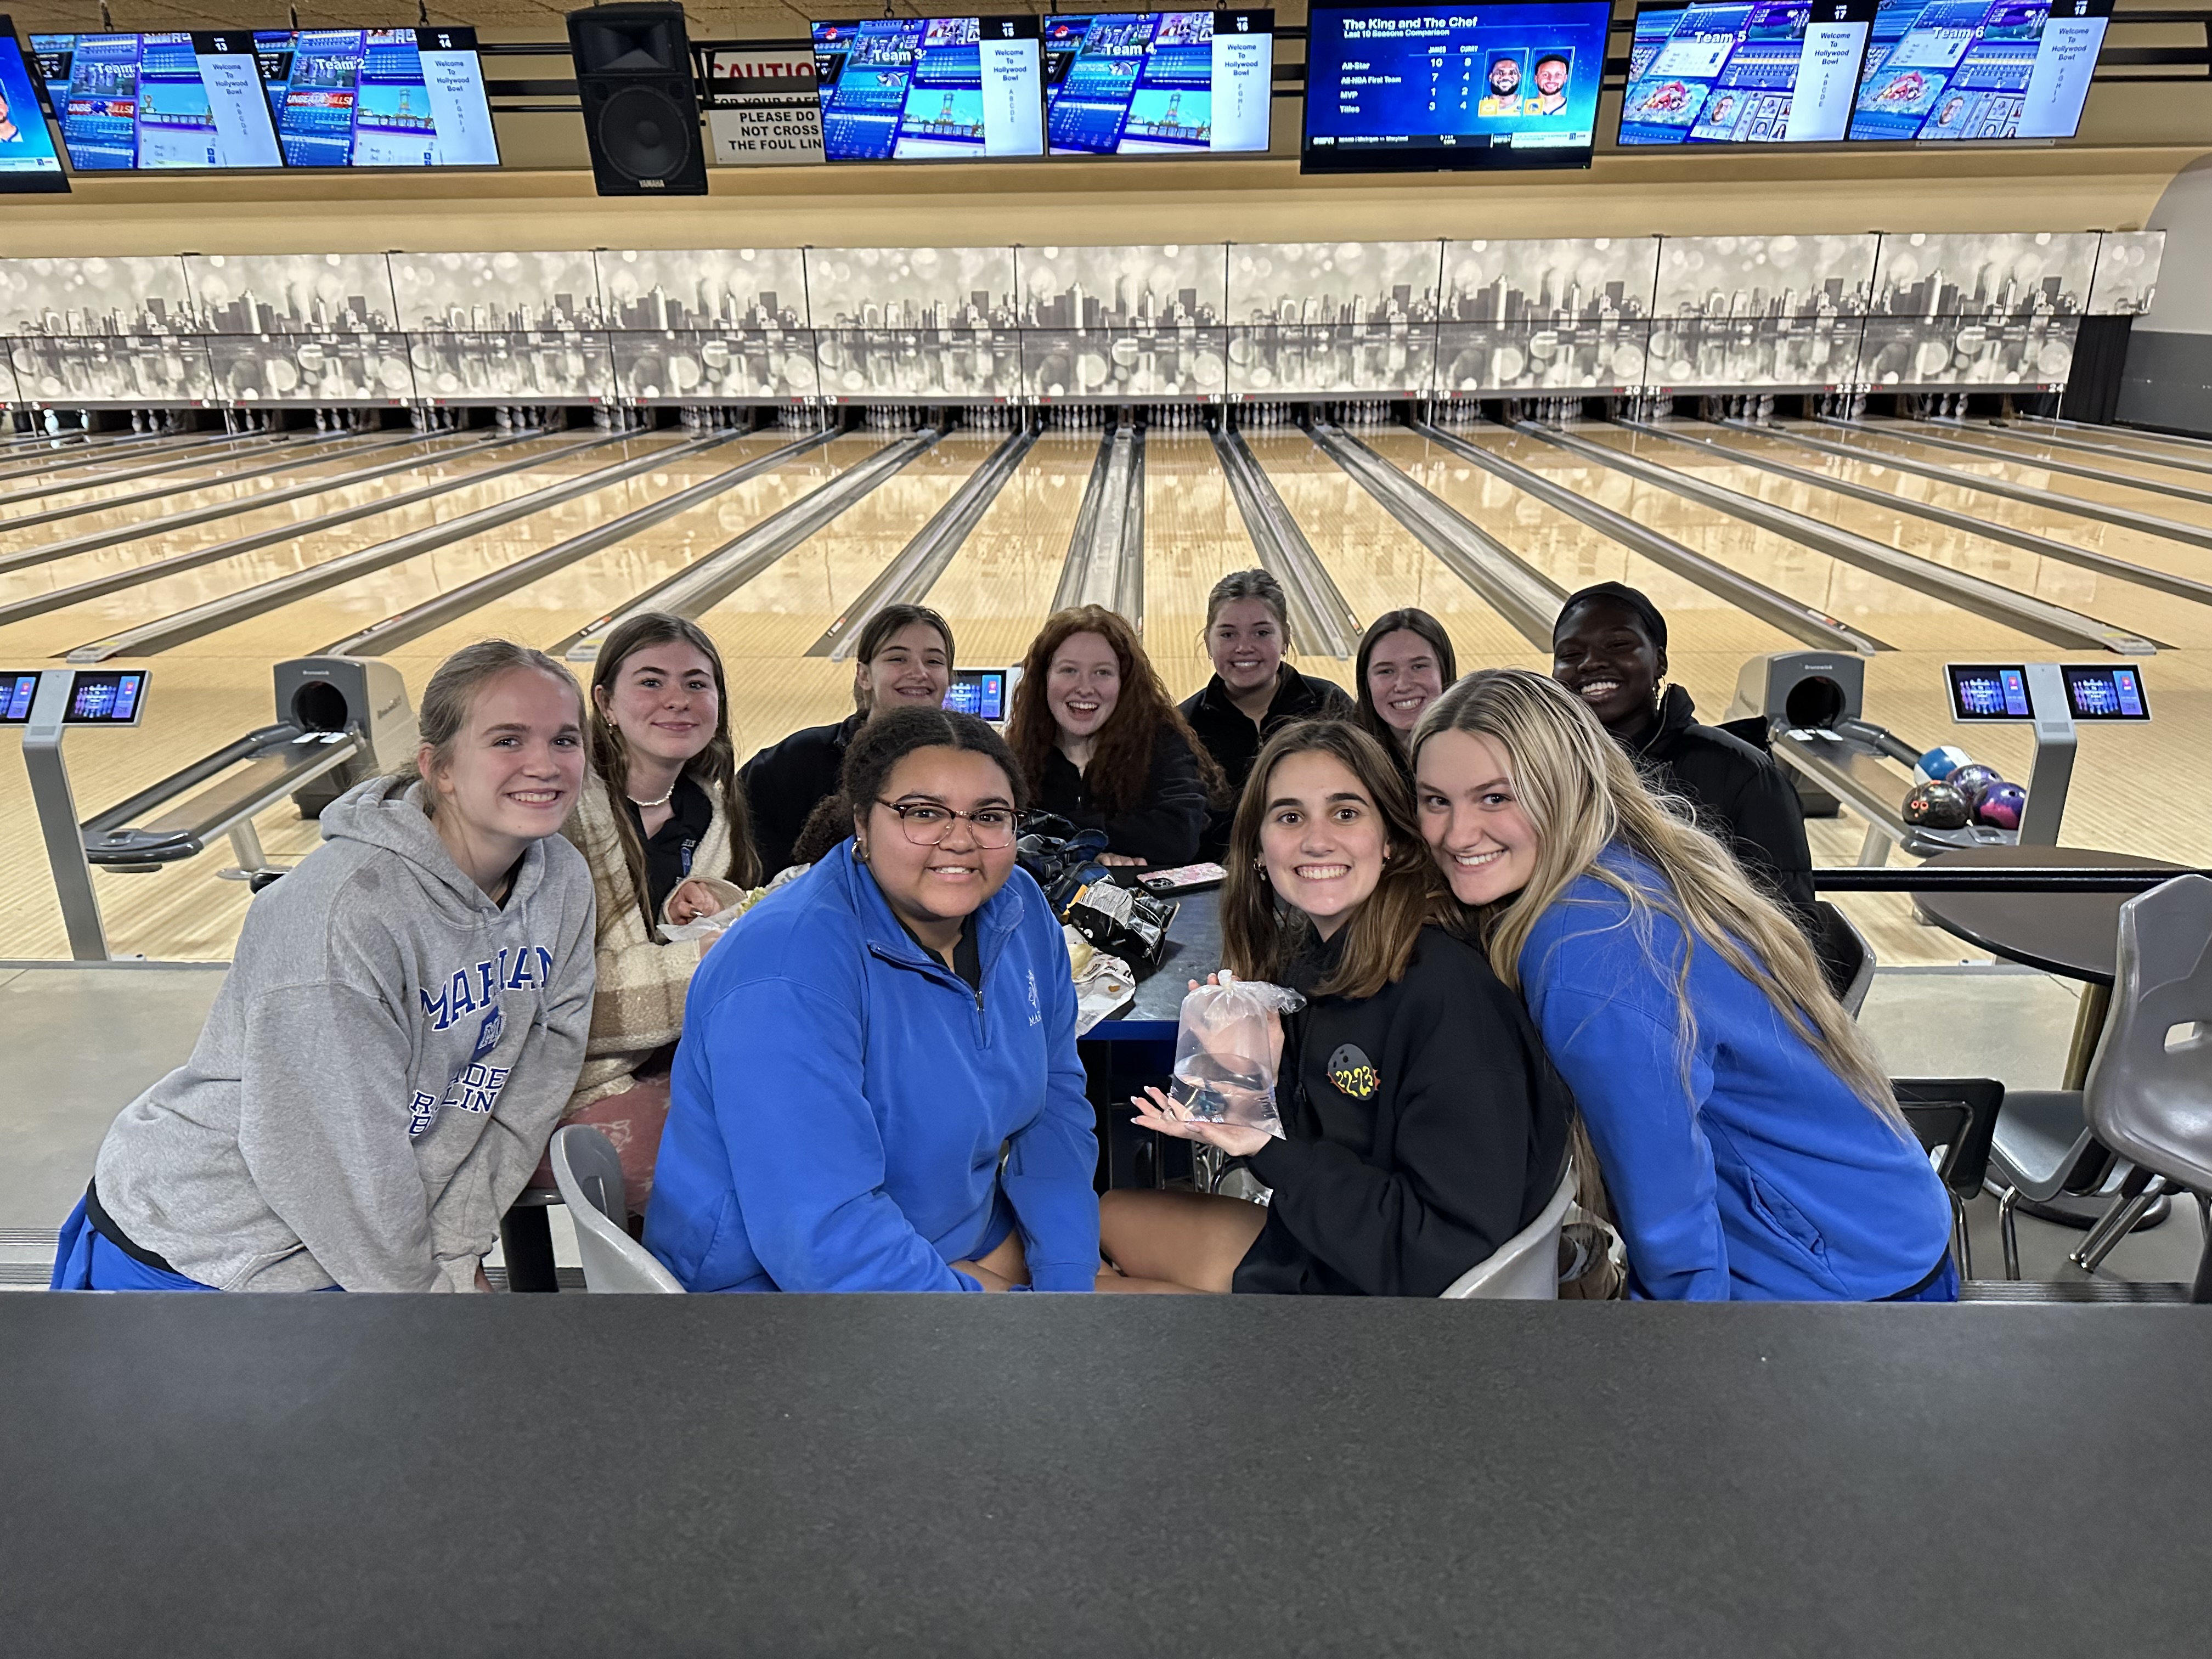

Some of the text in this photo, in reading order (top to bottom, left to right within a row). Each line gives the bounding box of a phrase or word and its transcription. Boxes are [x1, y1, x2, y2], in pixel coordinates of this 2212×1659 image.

[1835, 10, 1847, 20] 17
[1343, 16, 1478, 30] The King and The Chef
[1002, 27, 1014, 37] 15
[1344, 30, 1361, 38] Last
[1405, 29, 1450, 37] Comparison
[1933, 26, 1984, 40] Team 6
[1695, 31, 1746, 44] Team 5
[215, 43, 228, 51] 13
[1104, 42, 1155, 55] Team 4
[2052, 45, 2086, 53] Hollywood
[873, 48, 923, 62] Team 3
[94, 62, 143, 74] Team 1
[317, 58, 365, 70] Team 2
[1342, 58, 1471, 70] All-Star 10 8
[1368, 76, 1383, 84] First
[1432, 72, 1438, 82] 7
[1463, 72, 1470, 81] 4
[1431, 87, 1436, 96] 1
[1462, 87, 1468, 95] 2
[1429, 102, 1435, 111] 3
[1460, 101, 1466, 110] 4
[740, 111, 815, 122] PLEASE DO
[741, 125, 819, 136] NOT CROSS
[729, 139, 822, 150] THE FOUL LIN
[638, 179, 665, 188] YAMAHA
[1625, 386, 1640, 395] 20
[1647, 386, 1660, 395] 21
[1836, 383, 1851, 393] 22
[1856, 383, 1871, 393] 23
[2049, 383, 2064, 393] 24
[1209, 393, 1221, 404] 16
[1231, 393, 1243, 403] 17
[1415, 390, 1428, 399] 18
[227, 399, 234, 408] 7
[601, 396, 613, 405] 10
[626, 397, 636, 407] 11
[804, 396, 816, 405] 12
[825, 396, 837, 405] 13
[1006, 396, 1018, 405] 14
[1028, 396, 1040, 405] 15
[1336, 1065, 1373, 1097] 22-23
